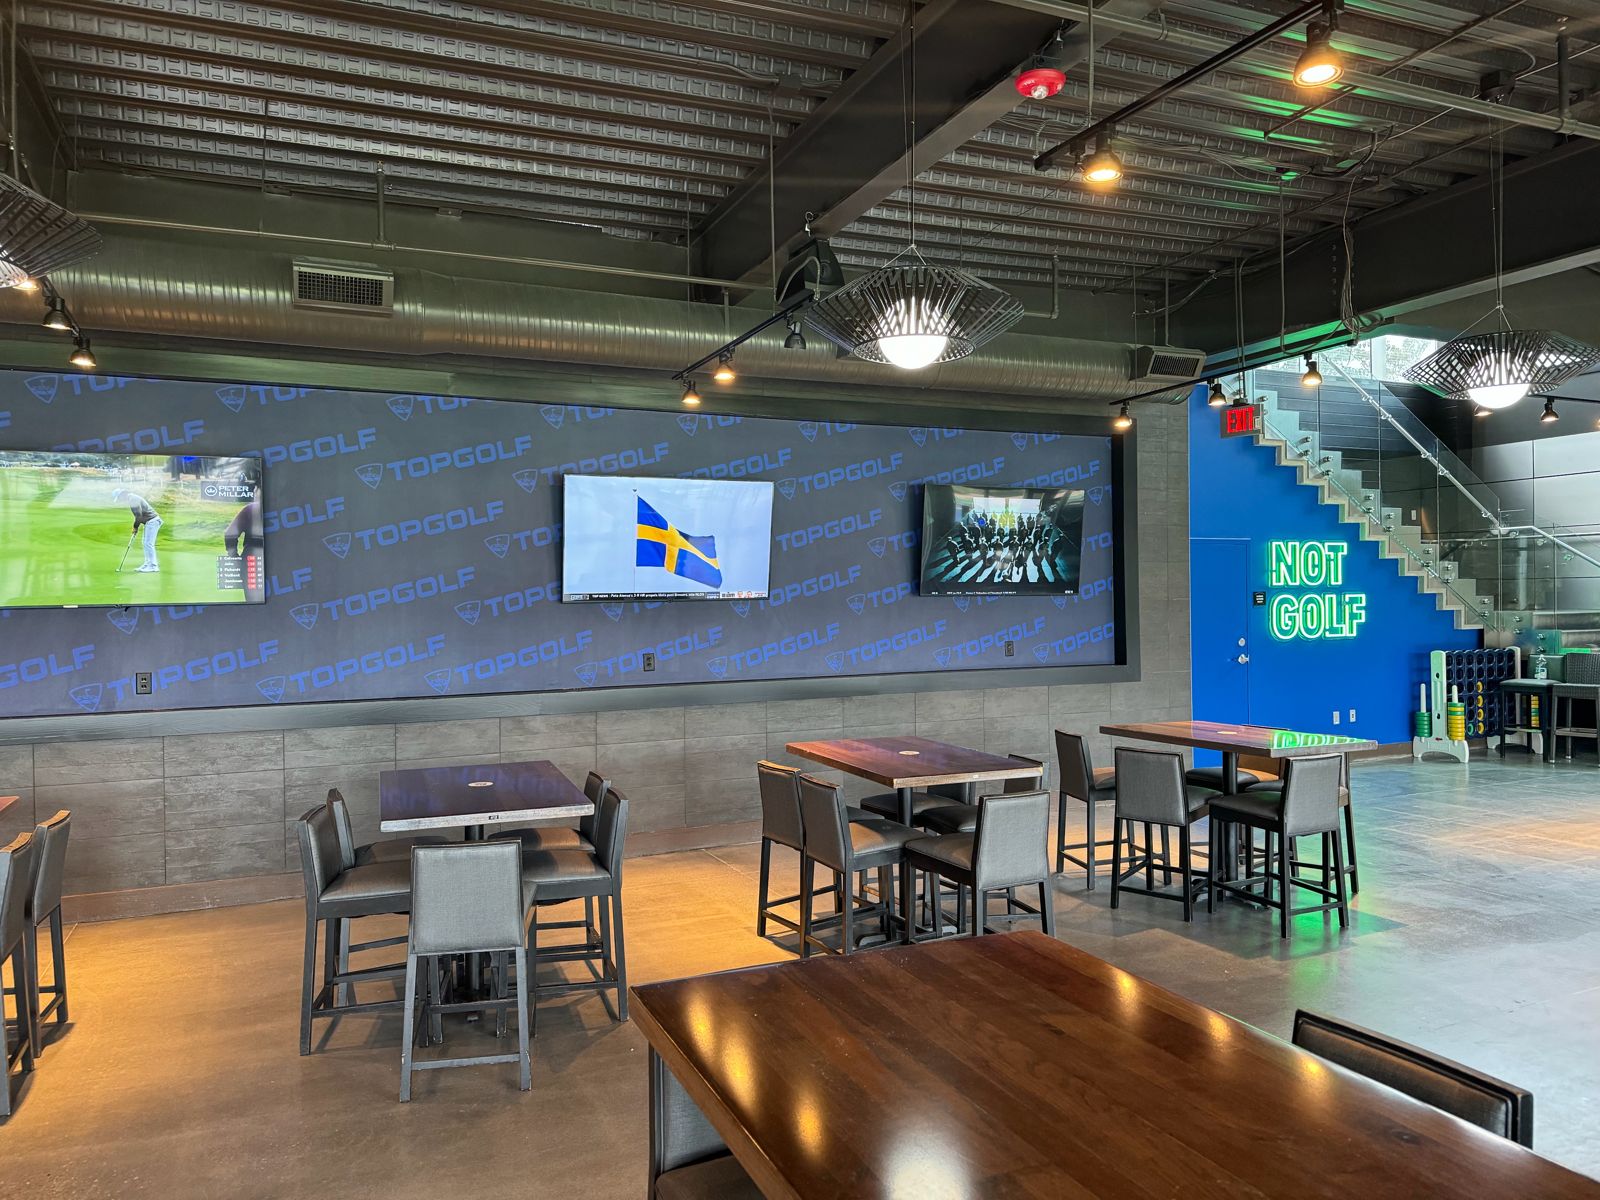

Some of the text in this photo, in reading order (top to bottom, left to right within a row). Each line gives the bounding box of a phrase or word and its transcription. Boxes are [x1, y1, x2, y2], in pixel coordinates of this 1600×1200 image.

[1226, 406, 1255, 433] EXIT
[386, 435, 532, 480] TOPGOLF
[799, 452, 904, 494] TOPGOLF
[355, 500, 504, 550] TOPGOLF
[775, 508, 882, 551] TOPGOLF
[1269, 541, 1348, 588] NOT
[322, 566, 475, 621] TOPGOLF
[1270, 593, 1366, 640] GOLF
[456, 630, 592, 684] TOPGOLF
[729, 623, 839, 672] TOPGOLF
[849, 619, 947, 666] TOPGOLF
[953, 616, 1046, 660] TOPGOLF
[289, 633, 445, 693] TOPGOLF
